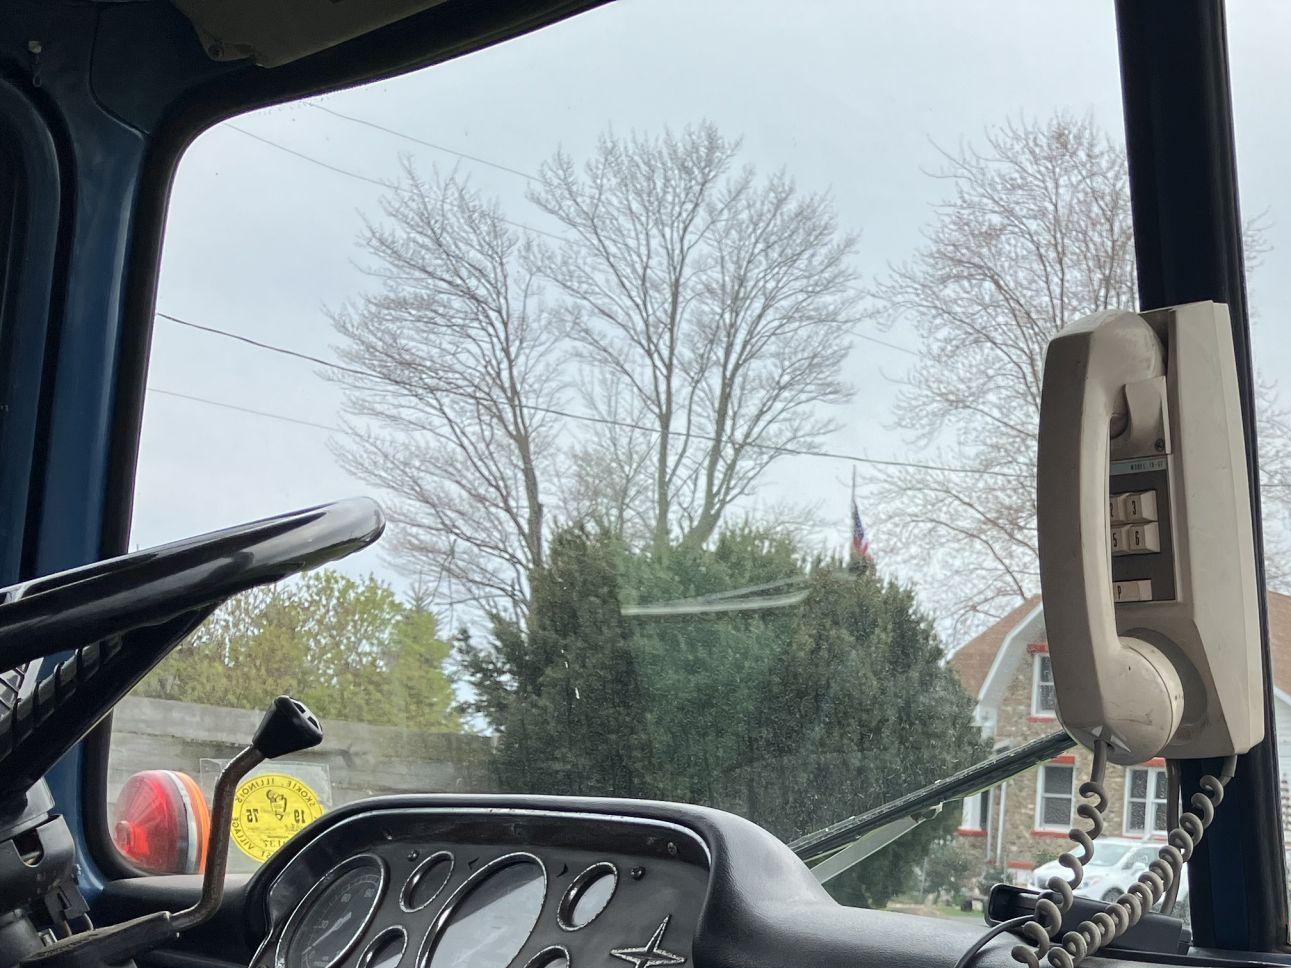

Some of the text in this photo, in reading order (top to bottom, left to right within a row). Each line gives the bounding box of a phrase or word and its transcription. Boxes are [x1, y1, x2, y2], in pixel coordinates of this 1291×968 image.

[1131, 500, 1137, 516] 3
[1112, 532, 1118, 548] 5
[1134, 530, 1140, 546] 6
